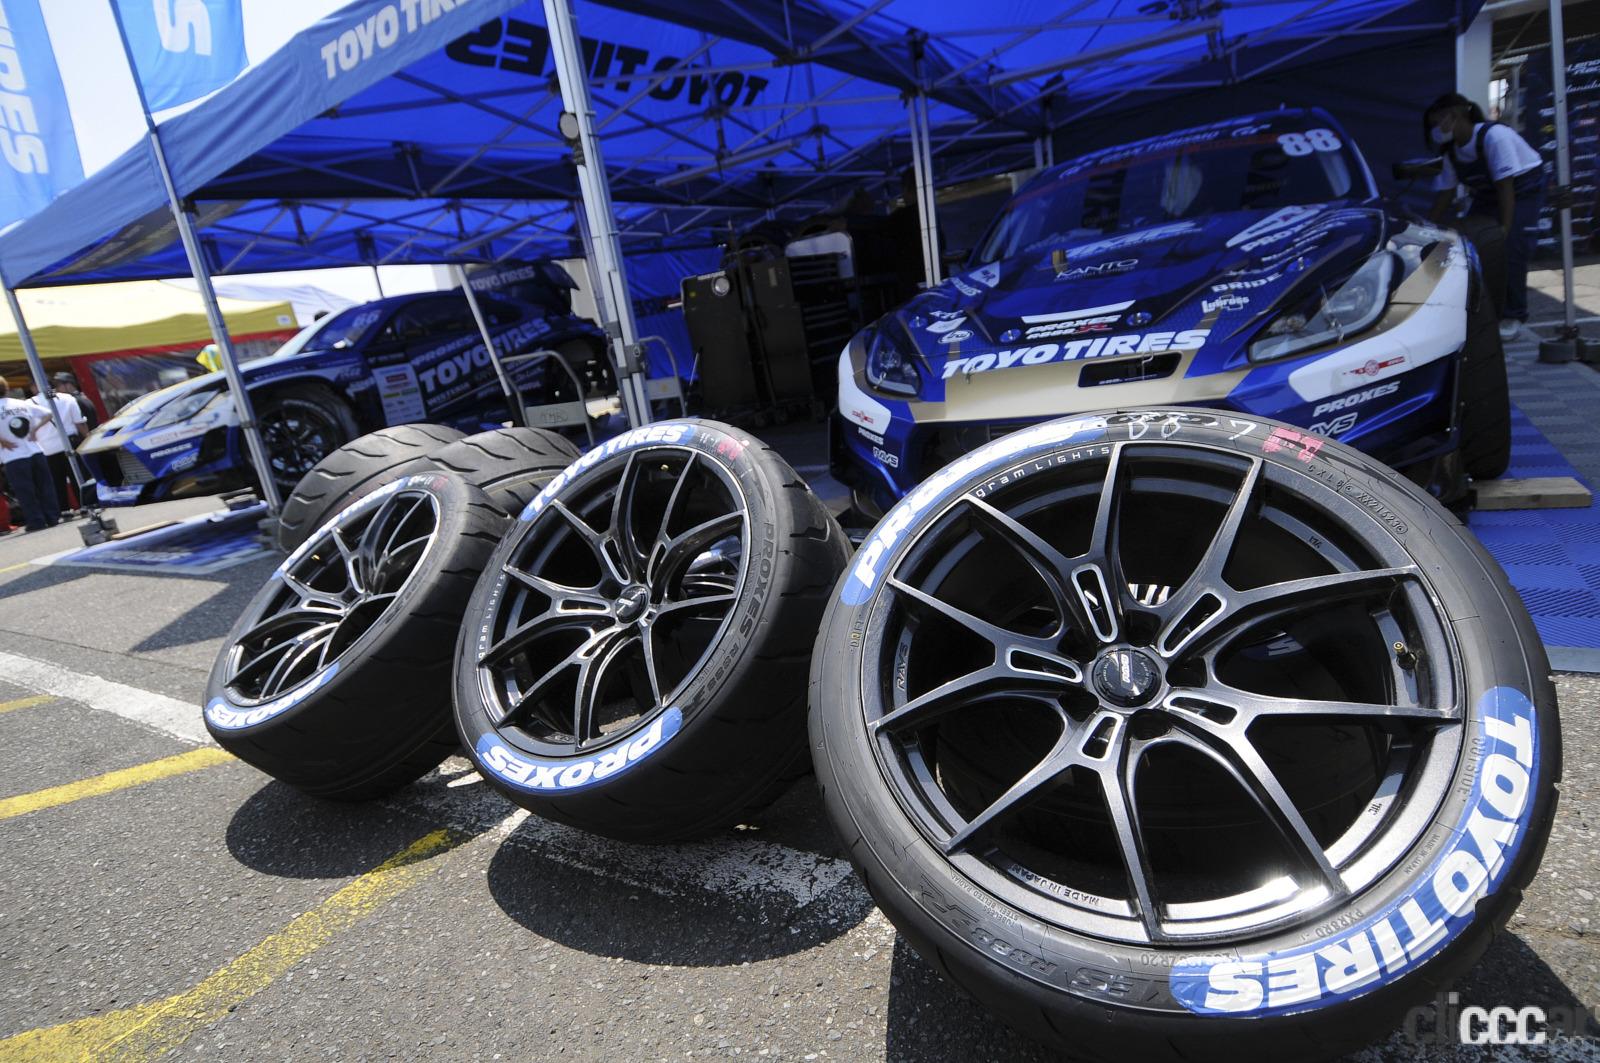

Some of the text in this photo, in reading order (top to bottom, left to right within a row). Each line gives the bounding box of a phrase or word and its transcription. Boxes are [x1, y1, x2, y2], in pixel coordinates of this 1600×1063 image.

[321, 5, 400, 80] TOYO
[1276, 127, 1343, 157] 88
[1056, 258, 1140, 279] KANTO
[1210, 271, 1284, 293] BRIDE
[1025, 313, 1123, 336] PROXES
[418, 340, 500, 394] TOYO
[940, 328, 1212, 380] TOYO TIRES
[1312, 377, 1401, 417] PROXES
[1309, 411, 1359, 438] AYS
[531, 424, 688, 513] TOYO TIRES
[872, 446, 900, 469] RAYS
[1034, 446, 1111, 471] LIGHTS
[739, 521, 776, 641] PROXES
[482, 716, 664, 788] PROXES
[1011, 862, 1101, 906] MADE IN JAPAN
[1203, 714, 1537, 1014] TOYO TIRES
